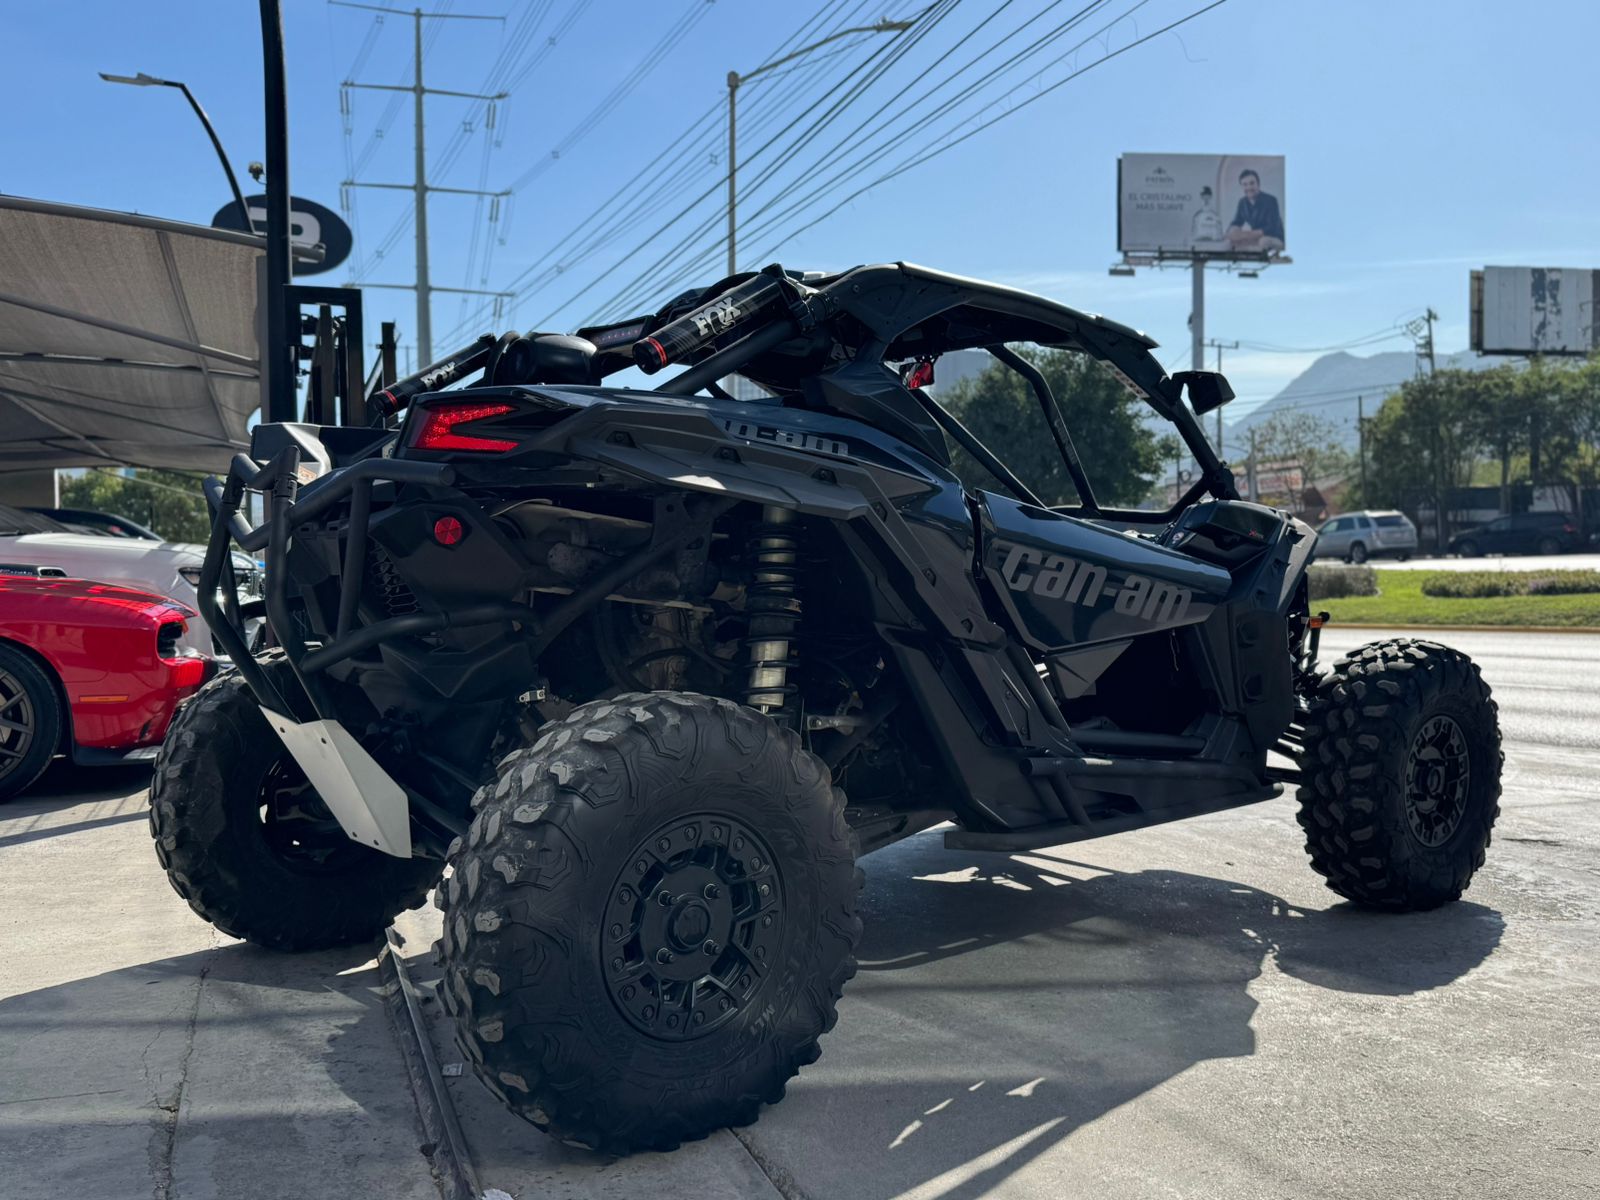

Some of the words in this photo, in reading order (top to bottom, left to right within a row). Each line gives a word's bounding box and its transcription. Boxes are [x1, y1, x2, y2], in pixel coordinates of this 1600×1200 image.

[1128, 193, 1138, 201] EL
[689, 296, 742, 337] FOX
[419, 361, 459, 389] FOX
[1001, 545, 1192, 623] can-am
